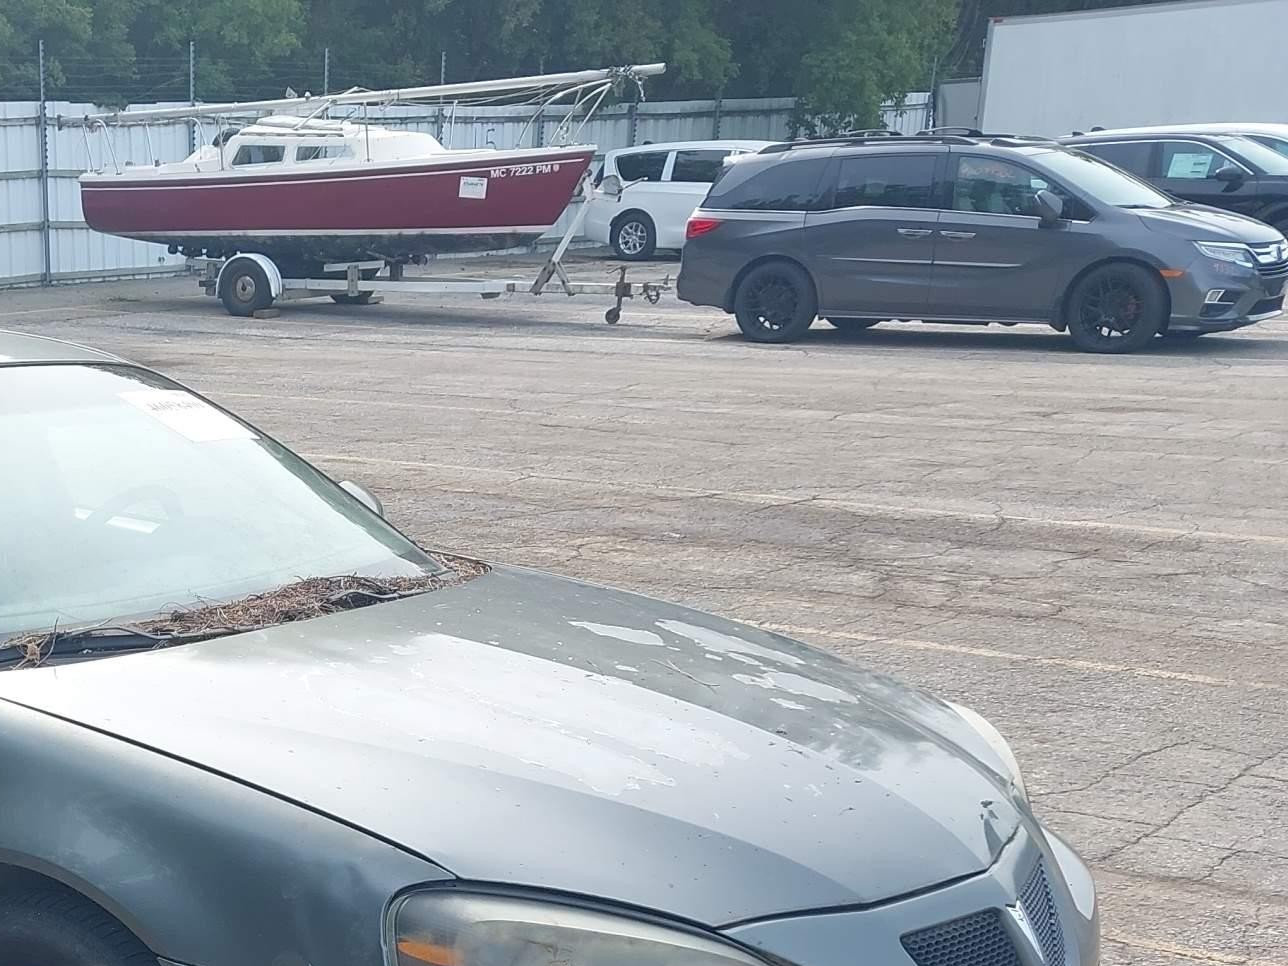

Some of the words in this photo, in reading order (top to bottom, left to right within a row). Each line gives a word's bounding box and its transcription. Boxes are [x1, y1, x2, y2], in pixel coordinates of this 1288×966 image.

[490, 168, 507, 178] MC
[509, 166, 534, 177] 7222
[536, 164, 552, 174] PM
